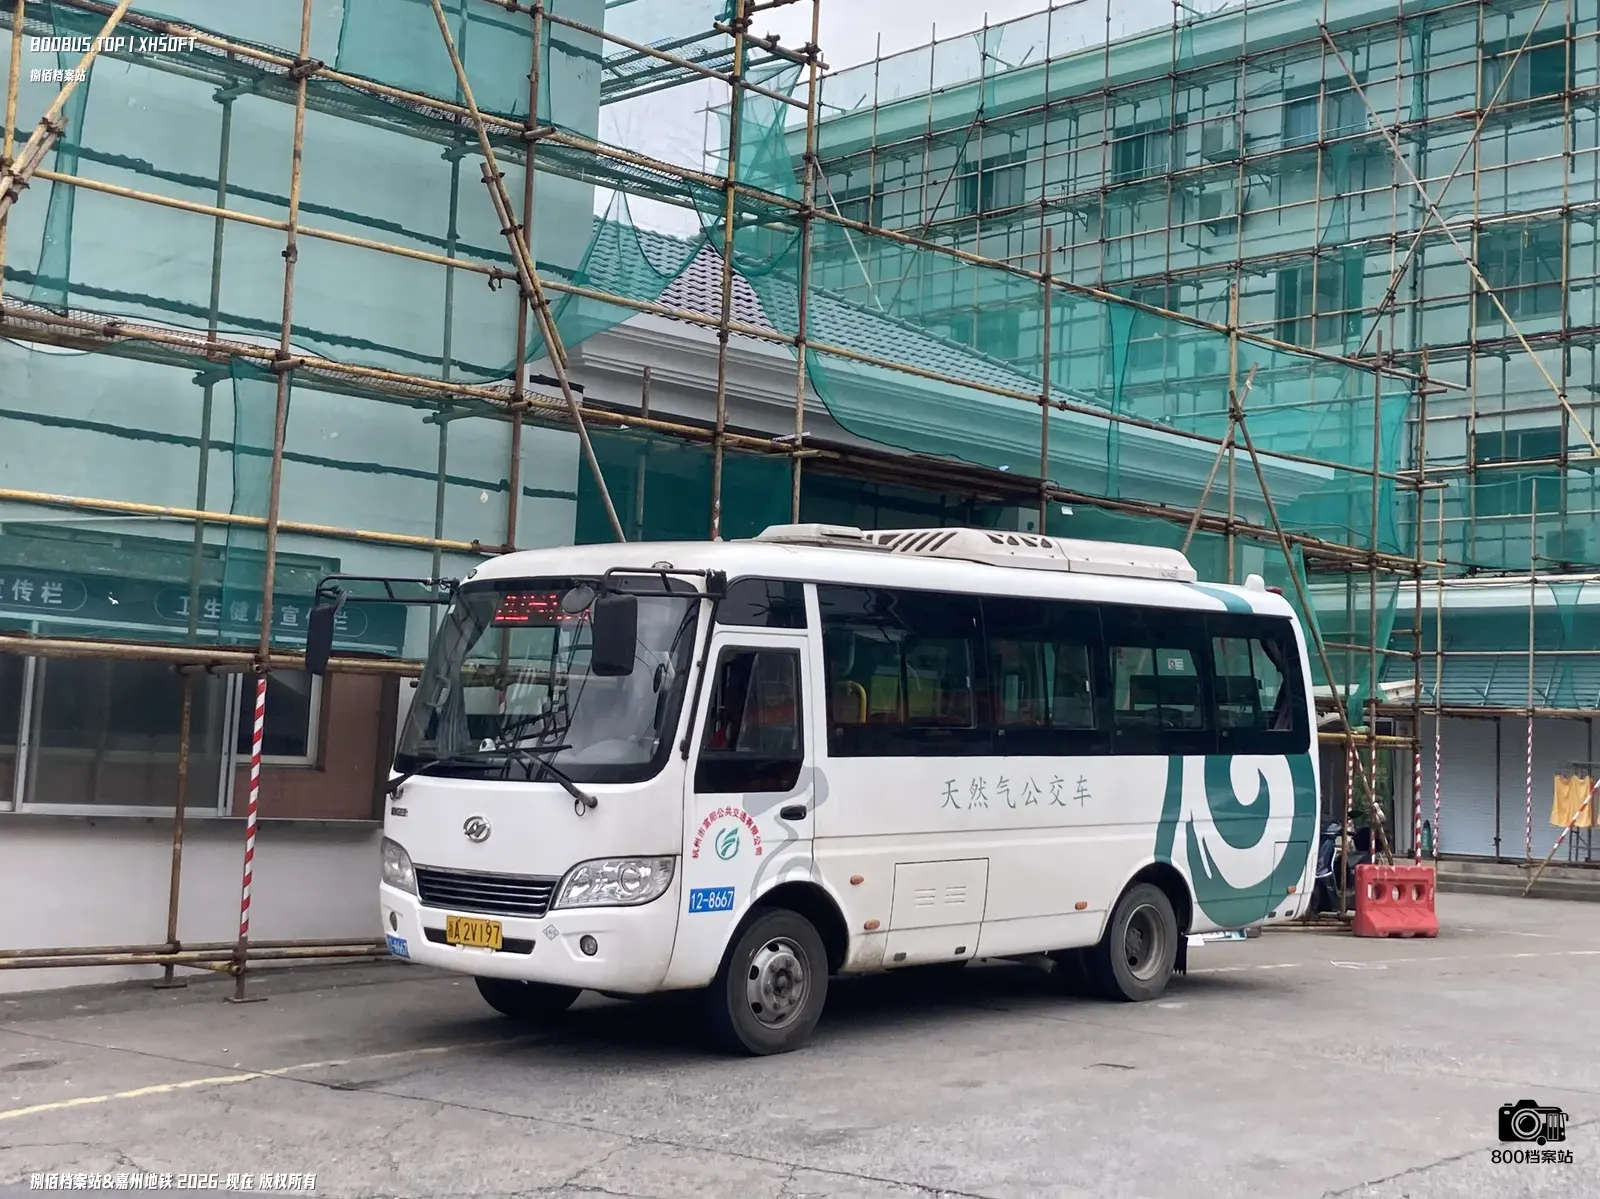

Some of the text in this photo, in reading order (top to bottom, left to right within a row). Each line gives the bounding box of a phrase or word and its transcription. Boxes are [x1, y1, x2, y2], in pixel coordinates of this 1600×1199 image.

[175, 595, 348, 630] 卫生健宣栏
[941, 774, 1092, 810] 天然气公交车
[691, 891, 734, 910] 12-8667
